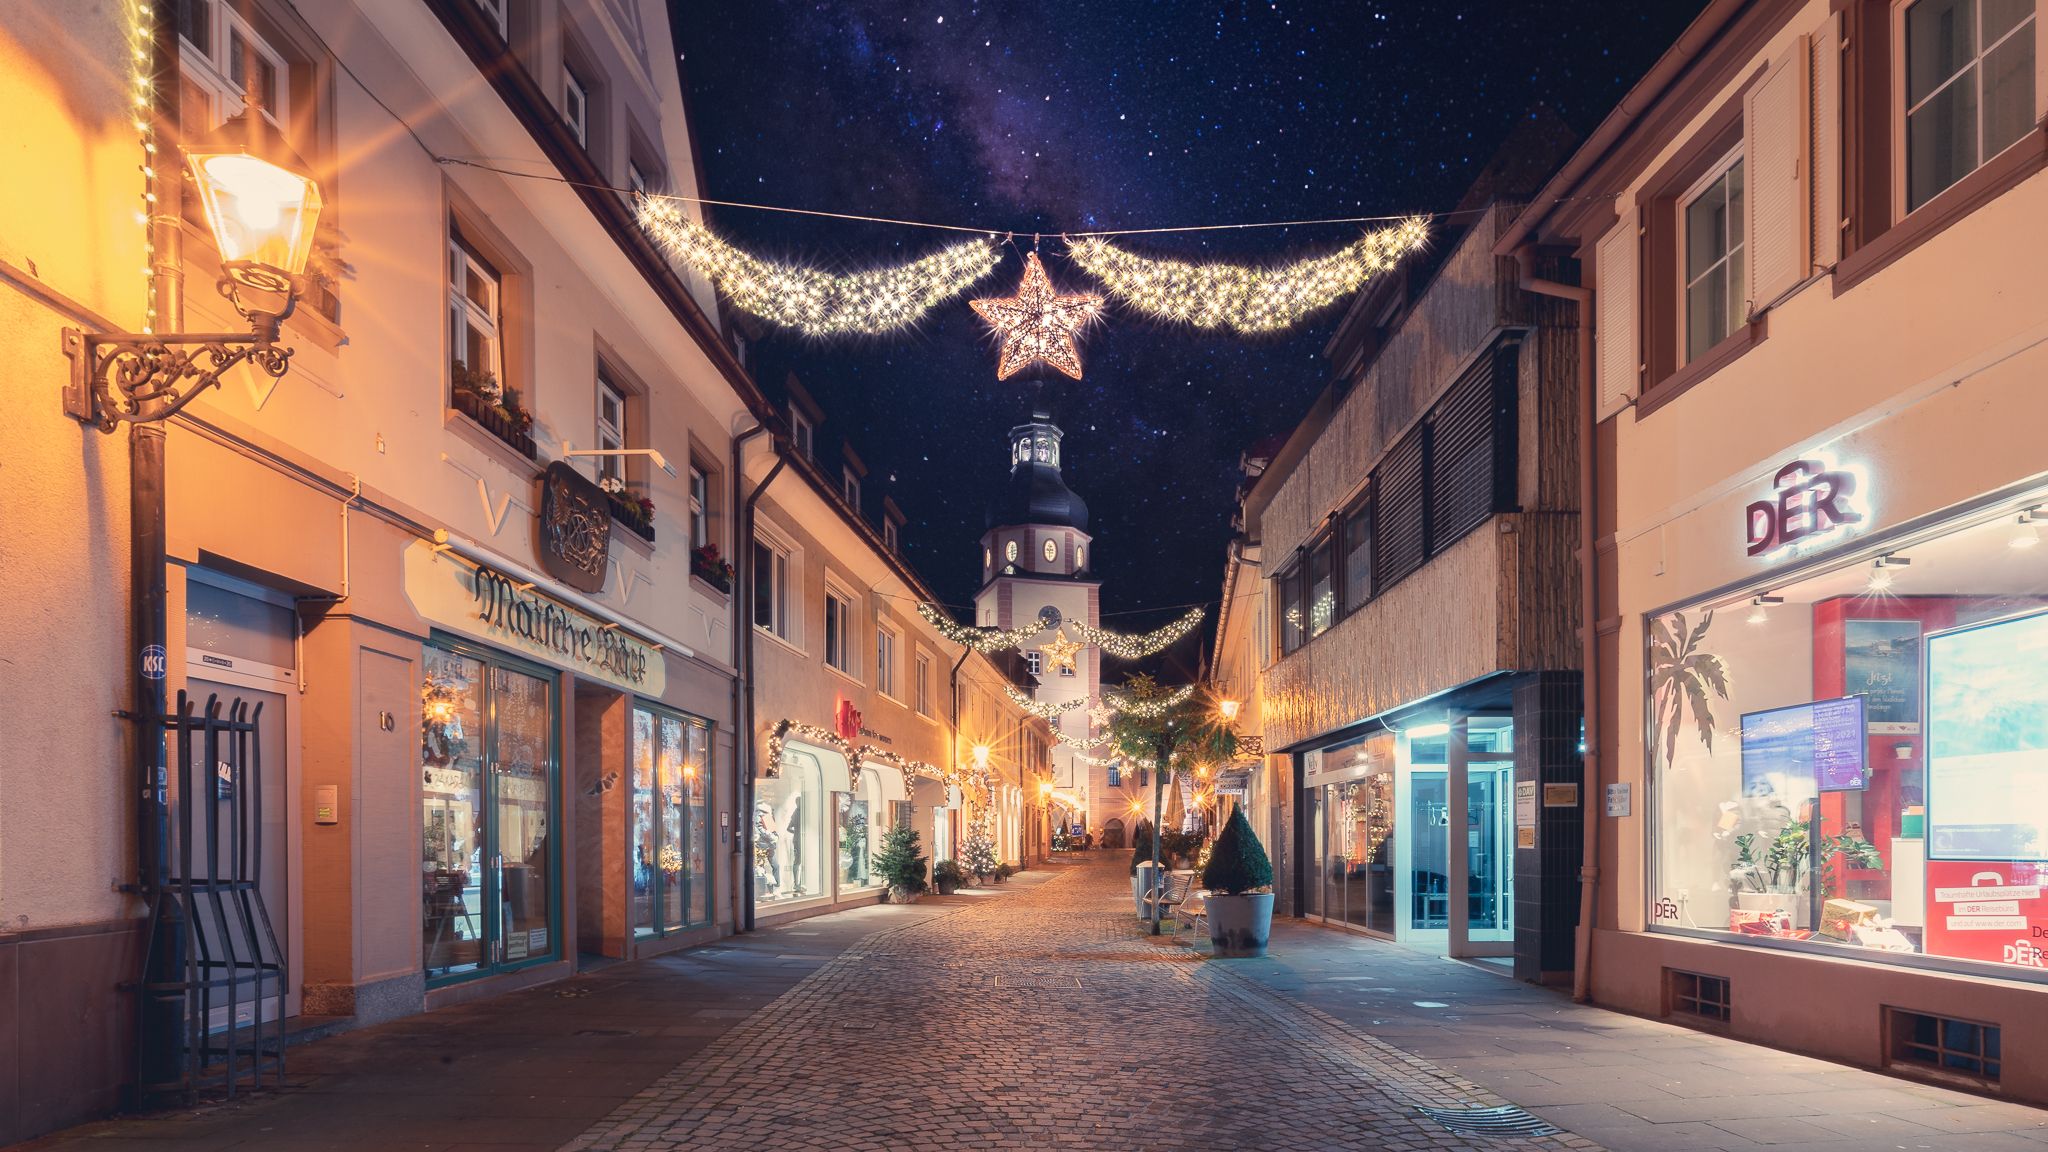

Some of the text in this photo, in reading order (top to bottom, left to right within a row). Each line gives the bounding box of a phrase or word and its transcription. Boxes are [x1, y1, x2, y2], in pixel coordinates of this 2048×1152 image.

[1746, 470, 1859, 557] DER
[143, 655, 165, 672] KSC
[379, 711, 395, 733] 10
[1655, 902, 1678, 919] DER
[2003, 944, 2044, 967] DER
